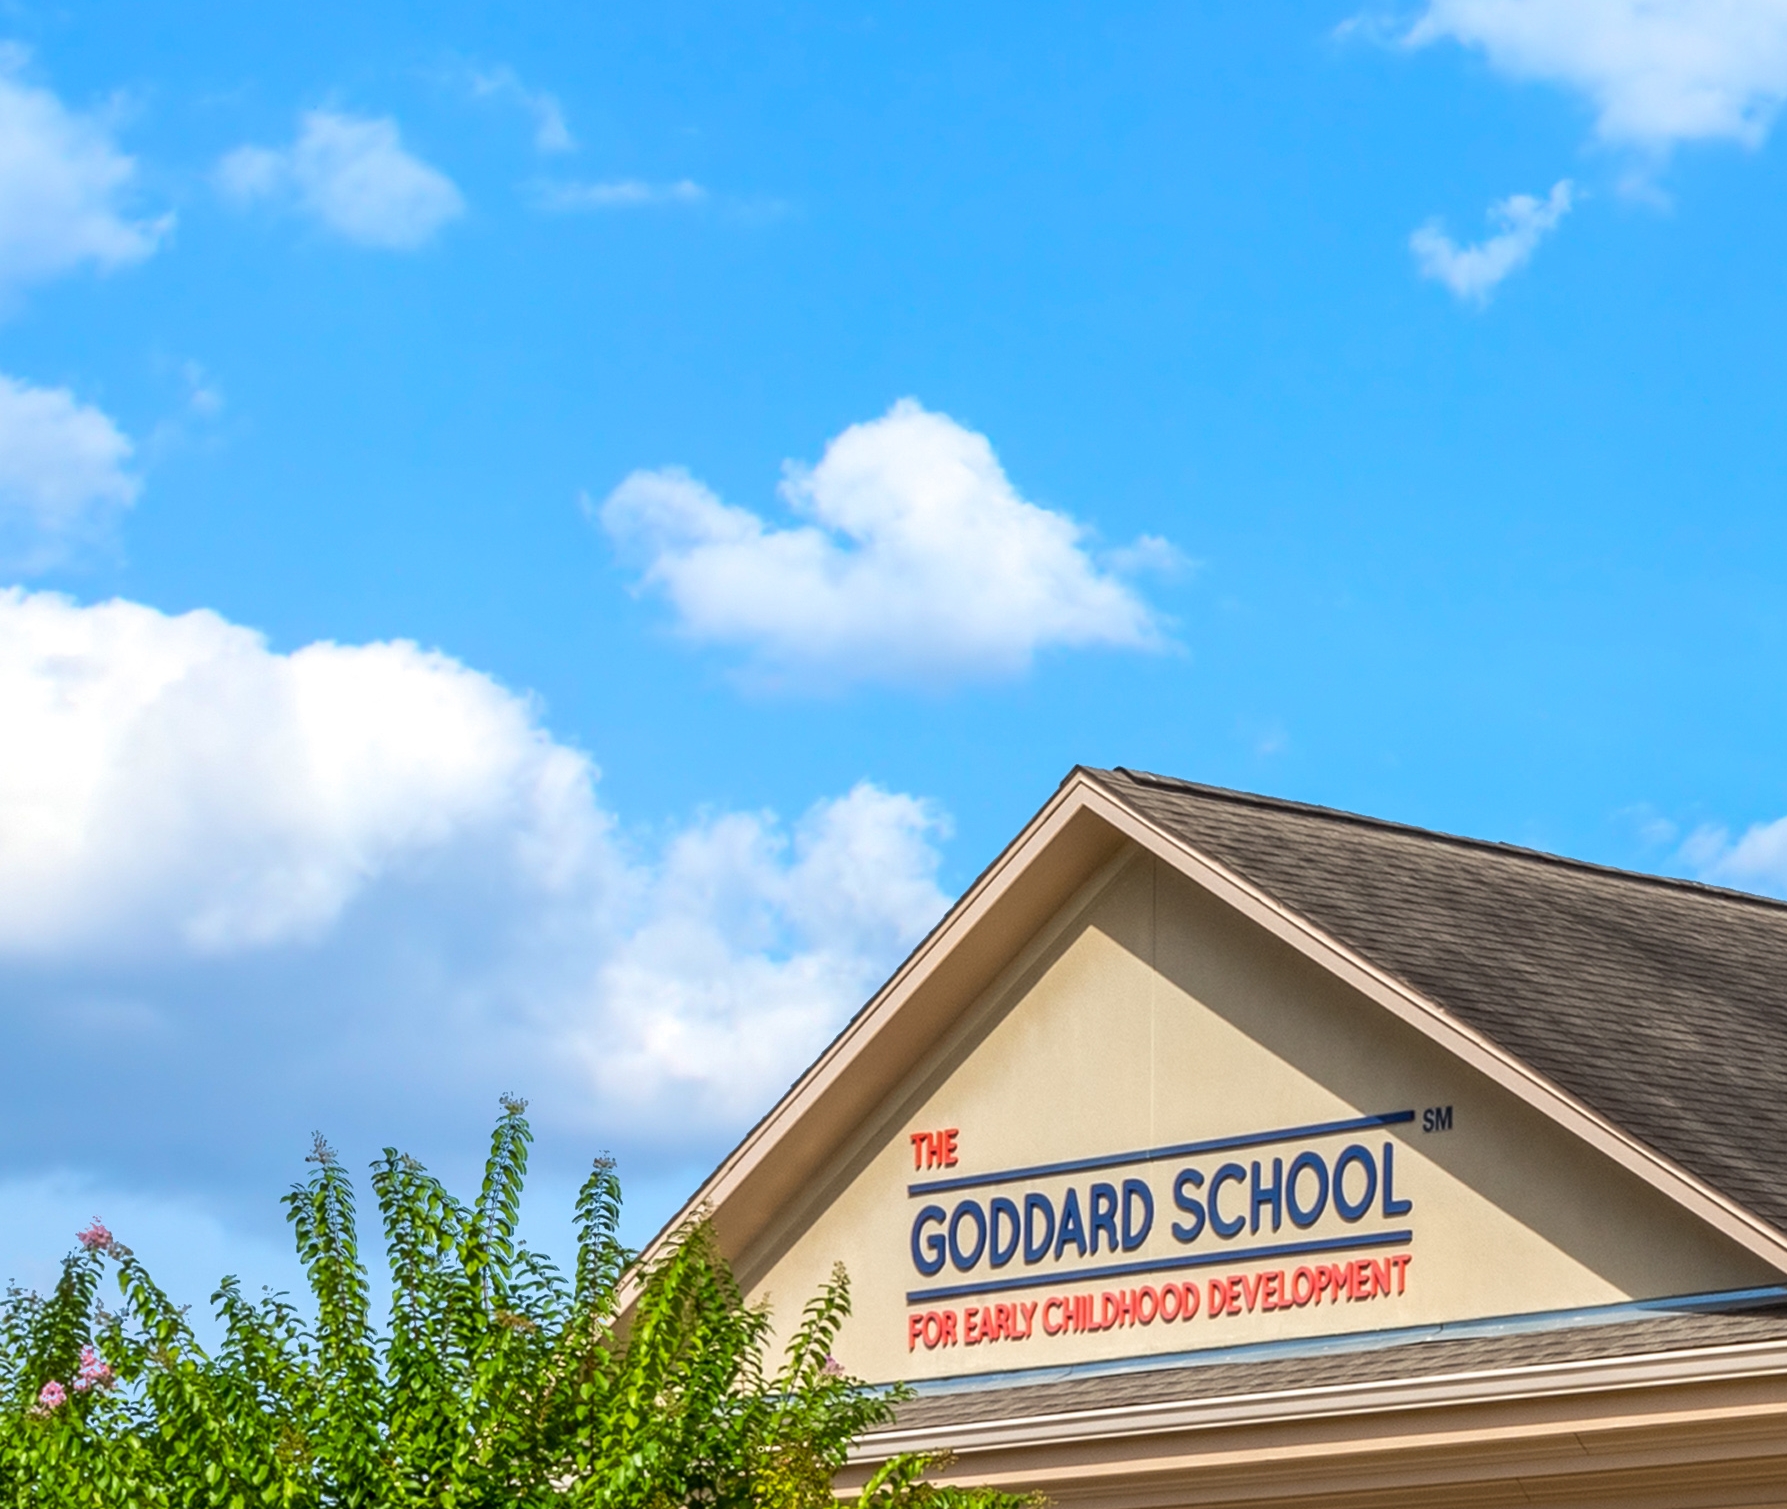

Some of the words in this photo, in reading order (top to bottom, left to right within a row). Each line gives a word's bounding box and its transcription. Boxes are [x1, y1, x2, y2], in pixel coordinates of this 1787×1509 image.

[910, 1128, 959, 1171] THE
[1423, 1106, 1453, 1134] SM
[911, 1178, 1154, 1277] GODDARD
[1172, 1142, 1412, 1244] SCHOOL
[908, 1311, 957, 1352] FOR
[964, 1301, 1037, 1346] EARLY
[1042, 1282, 1199, 1337] CHILDHOOD
[1208, 1254, 1412, 1319] DEVELOPMENT
